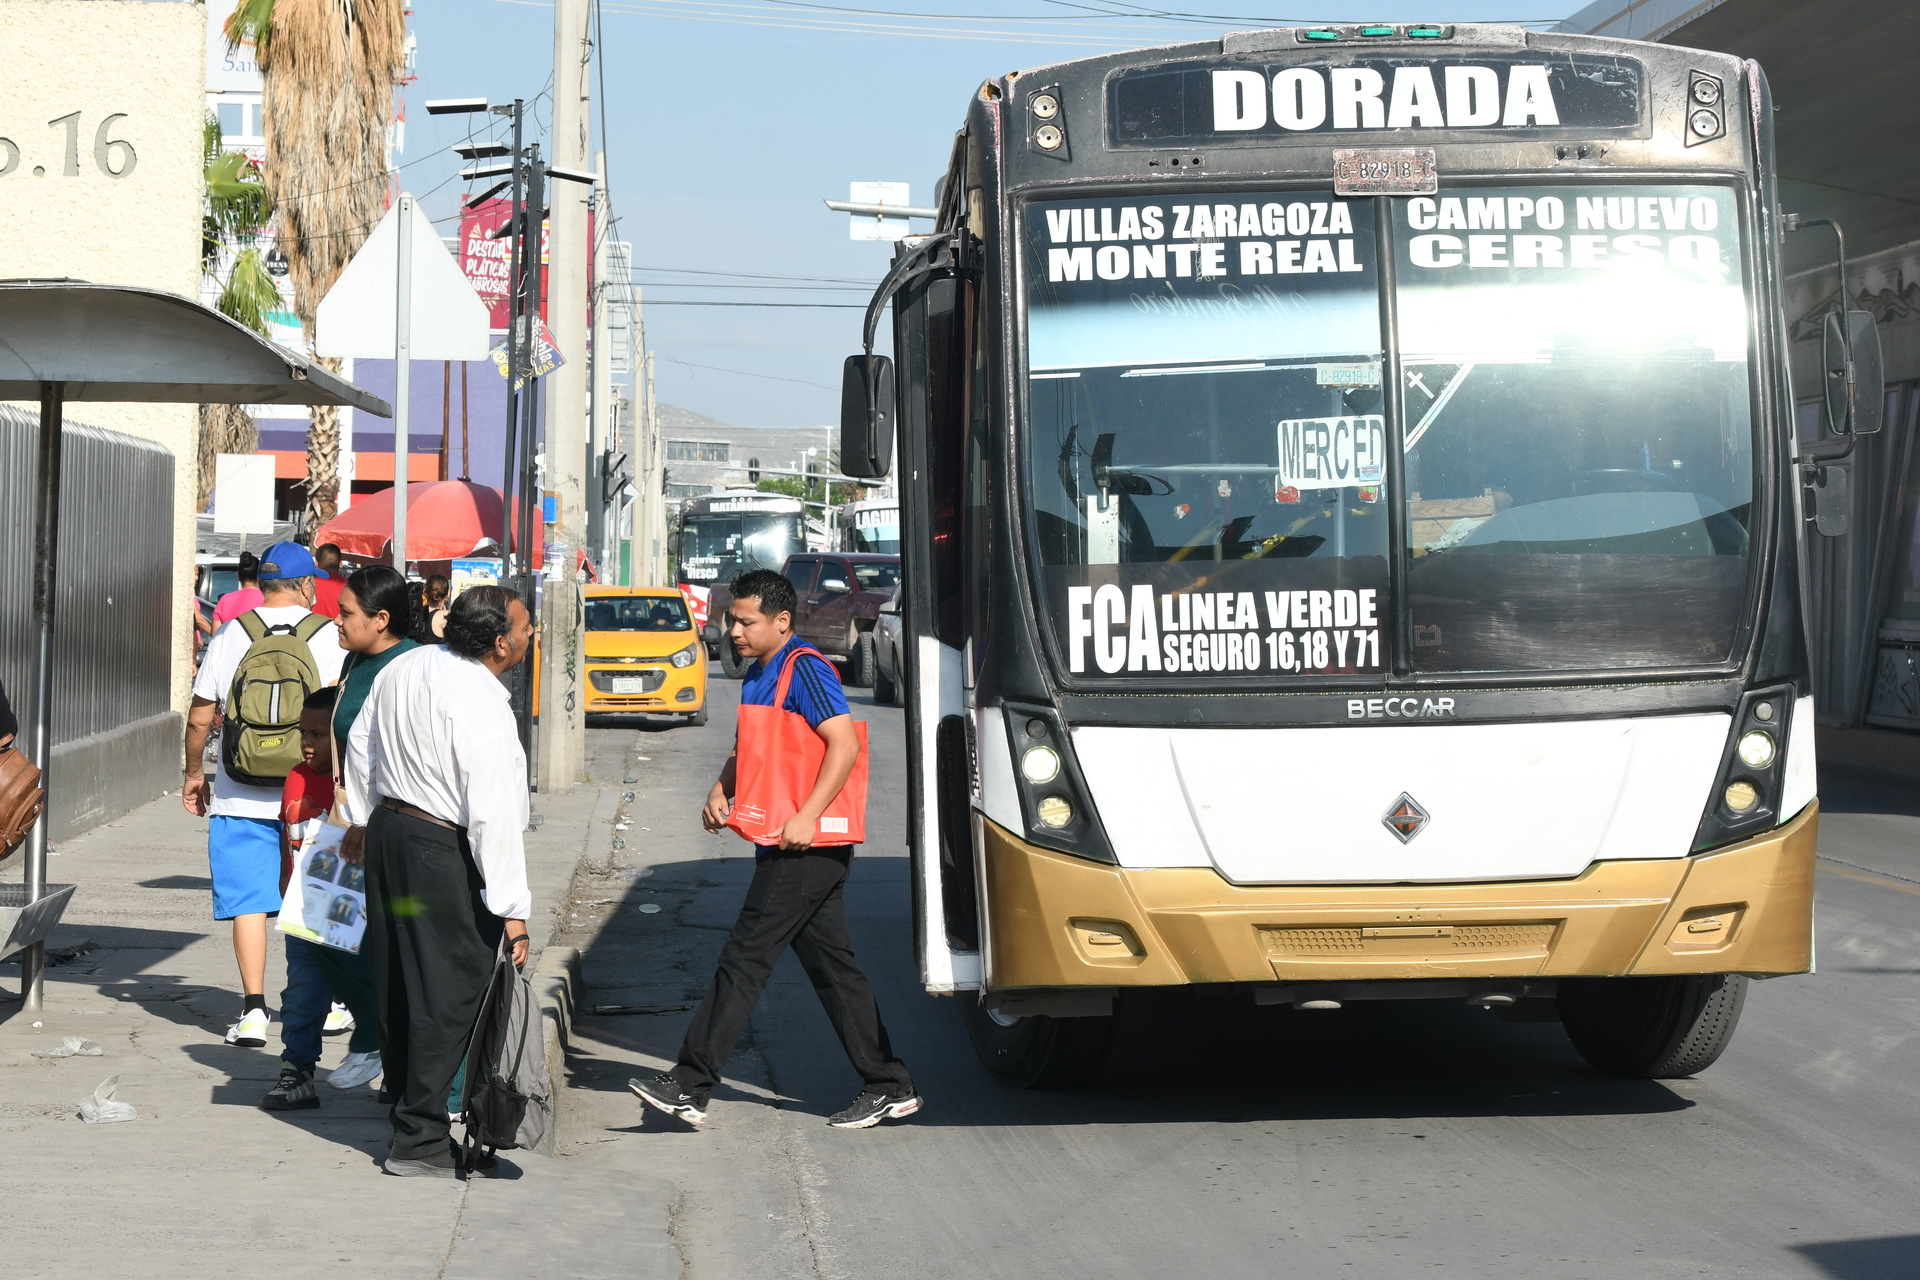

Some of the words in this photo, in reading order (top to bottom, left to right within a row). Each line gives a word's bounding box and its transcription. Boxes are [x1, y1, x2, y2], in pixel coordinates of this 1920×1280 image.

[1213, 65, 1559, 131] DORADA
[1338, 160, 1433, 180] C-82918-C
[1046, 206, 1164, 243] VILLAS
[1172, 202, 1353, 239] ZARAGOZA
[1407, 196, 1565, 231] CAMPO
[1577, 196, 1719, 230] NUEVO
[1048, 242, 1227, 282] MONTE
[1240, 238, 1363, 275] REAL
[1409, 233, 1721, 270] CERESO
[1321, 370, 1375, 383] C-82918-C
[1282, 419, 1385, 480] MERCED
[687, 568, 718, 580] VIESCA
[689, 557, 721, 565] CENTRO
[1068, 584, 1162, 674] FCA
[1162, 592, 1259, 632] LINEA
[1264, 589, 1378, 629] VERDE
[1163, 631, 1261, 673] SEGURO
[1265, 630, 1329, 674] 16,18
[1334, 630, 1350, 668] Y
[1354, 629, 1380, 667] 71
[1347, 697, 1456, 719] BECCAR
